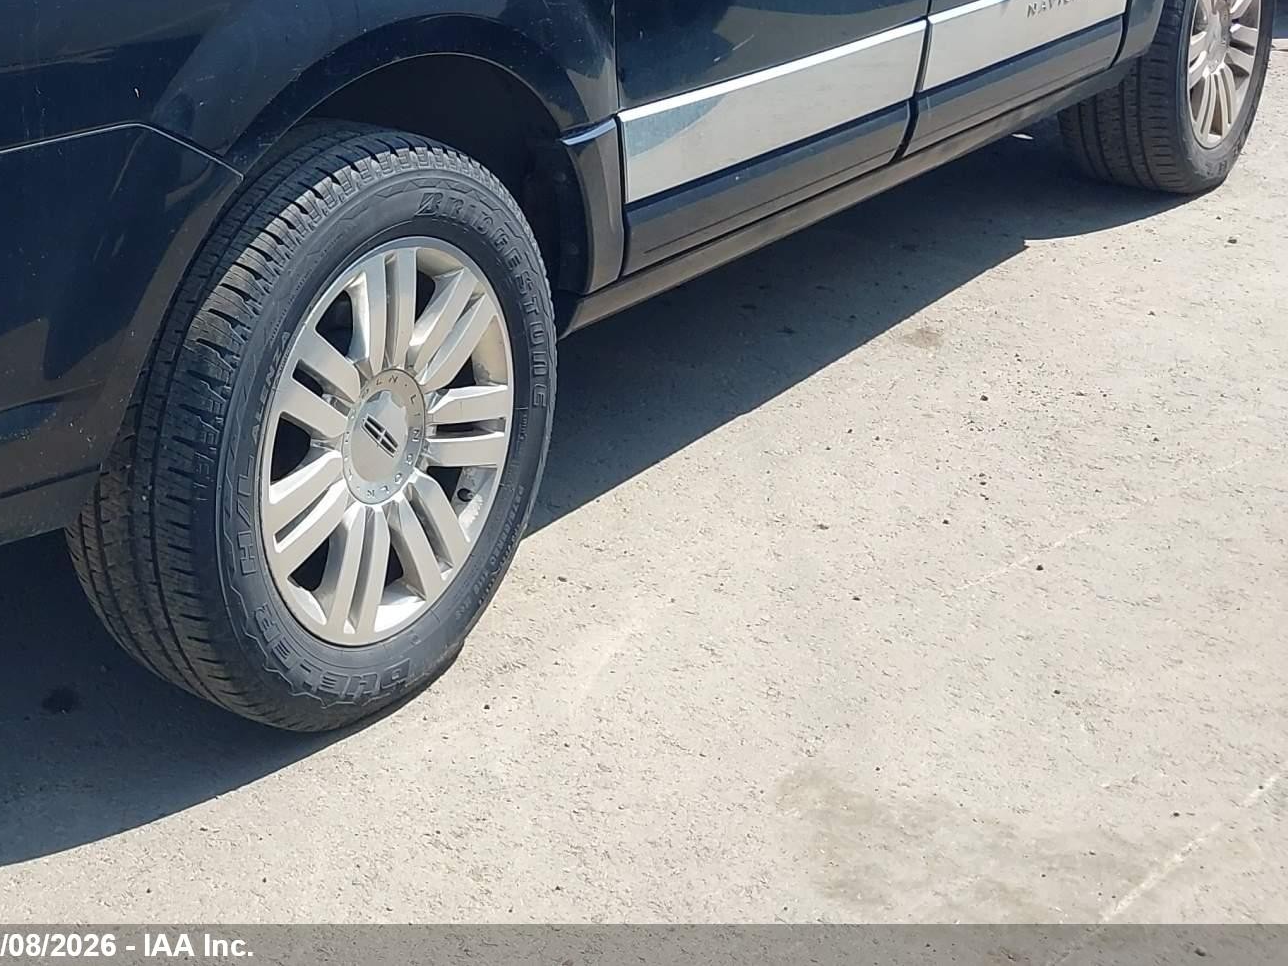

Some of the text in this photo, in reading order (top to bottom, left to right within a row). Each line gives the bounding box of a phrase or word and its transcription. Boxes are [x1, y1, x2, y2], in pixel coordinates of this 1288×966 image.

[414, 192, 549, 409] BRIDGESTONE
[251, 326, 294, 446] ALENZA
[254, 603, 412, 699] DUELER
